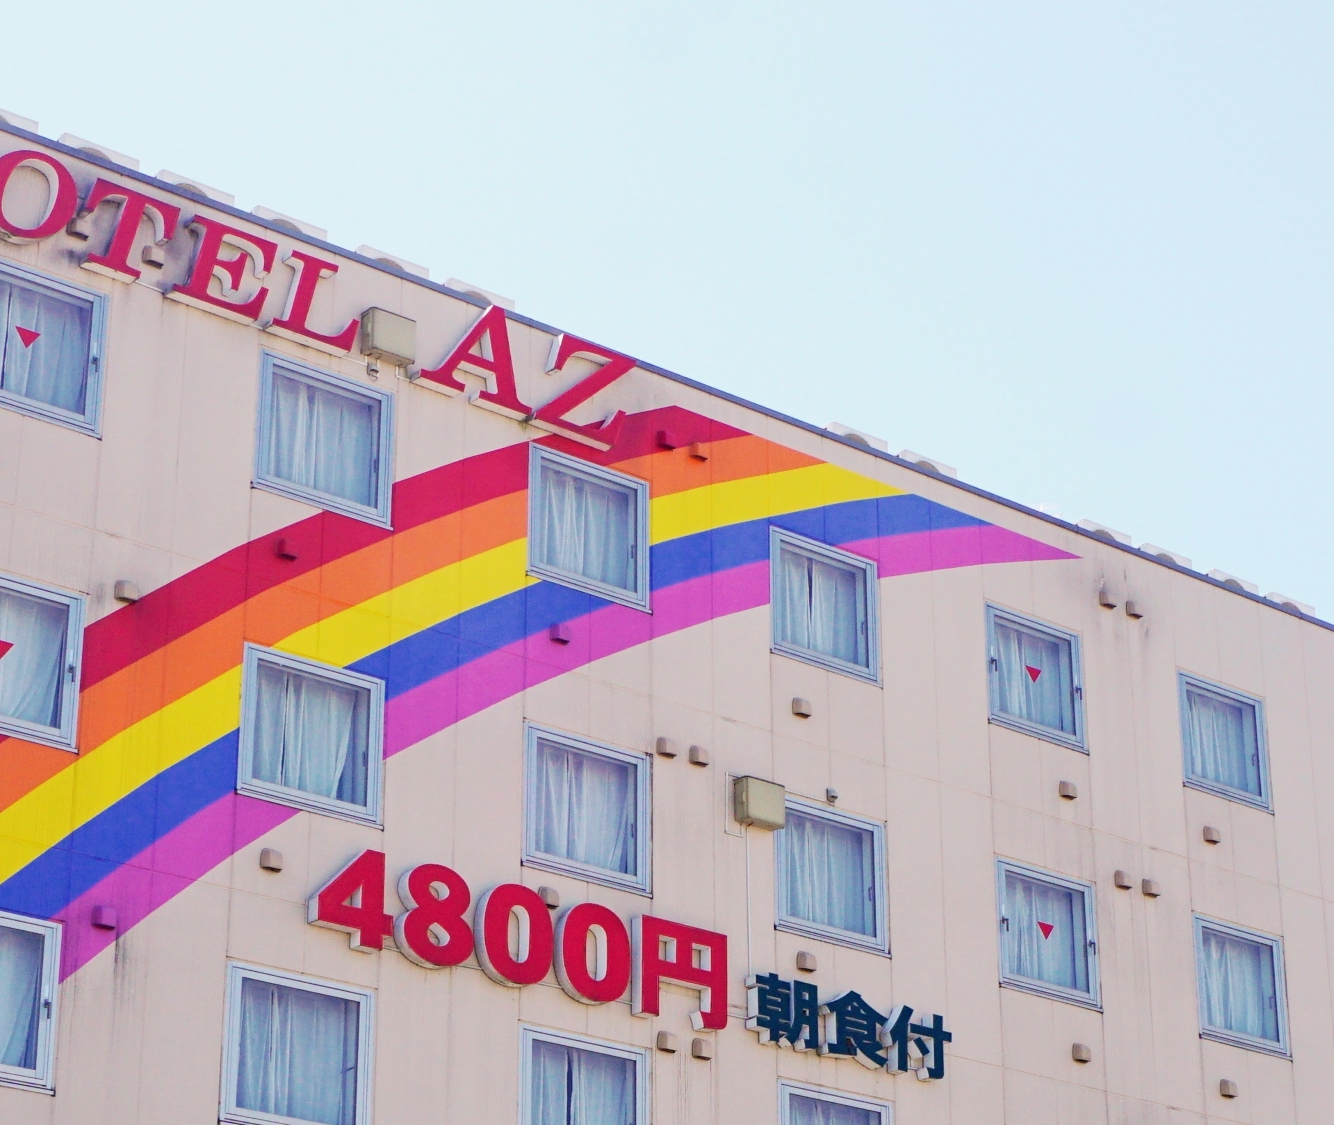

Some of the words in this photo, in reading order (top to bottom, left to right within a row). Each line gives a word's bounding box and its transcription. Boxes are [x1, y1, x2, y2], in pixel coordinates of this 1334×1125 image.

[410, 305, 636, 452] AZ
[308, 849, 728, 1032] 4800円
[745, 972, 952, 1082] 朝食付
